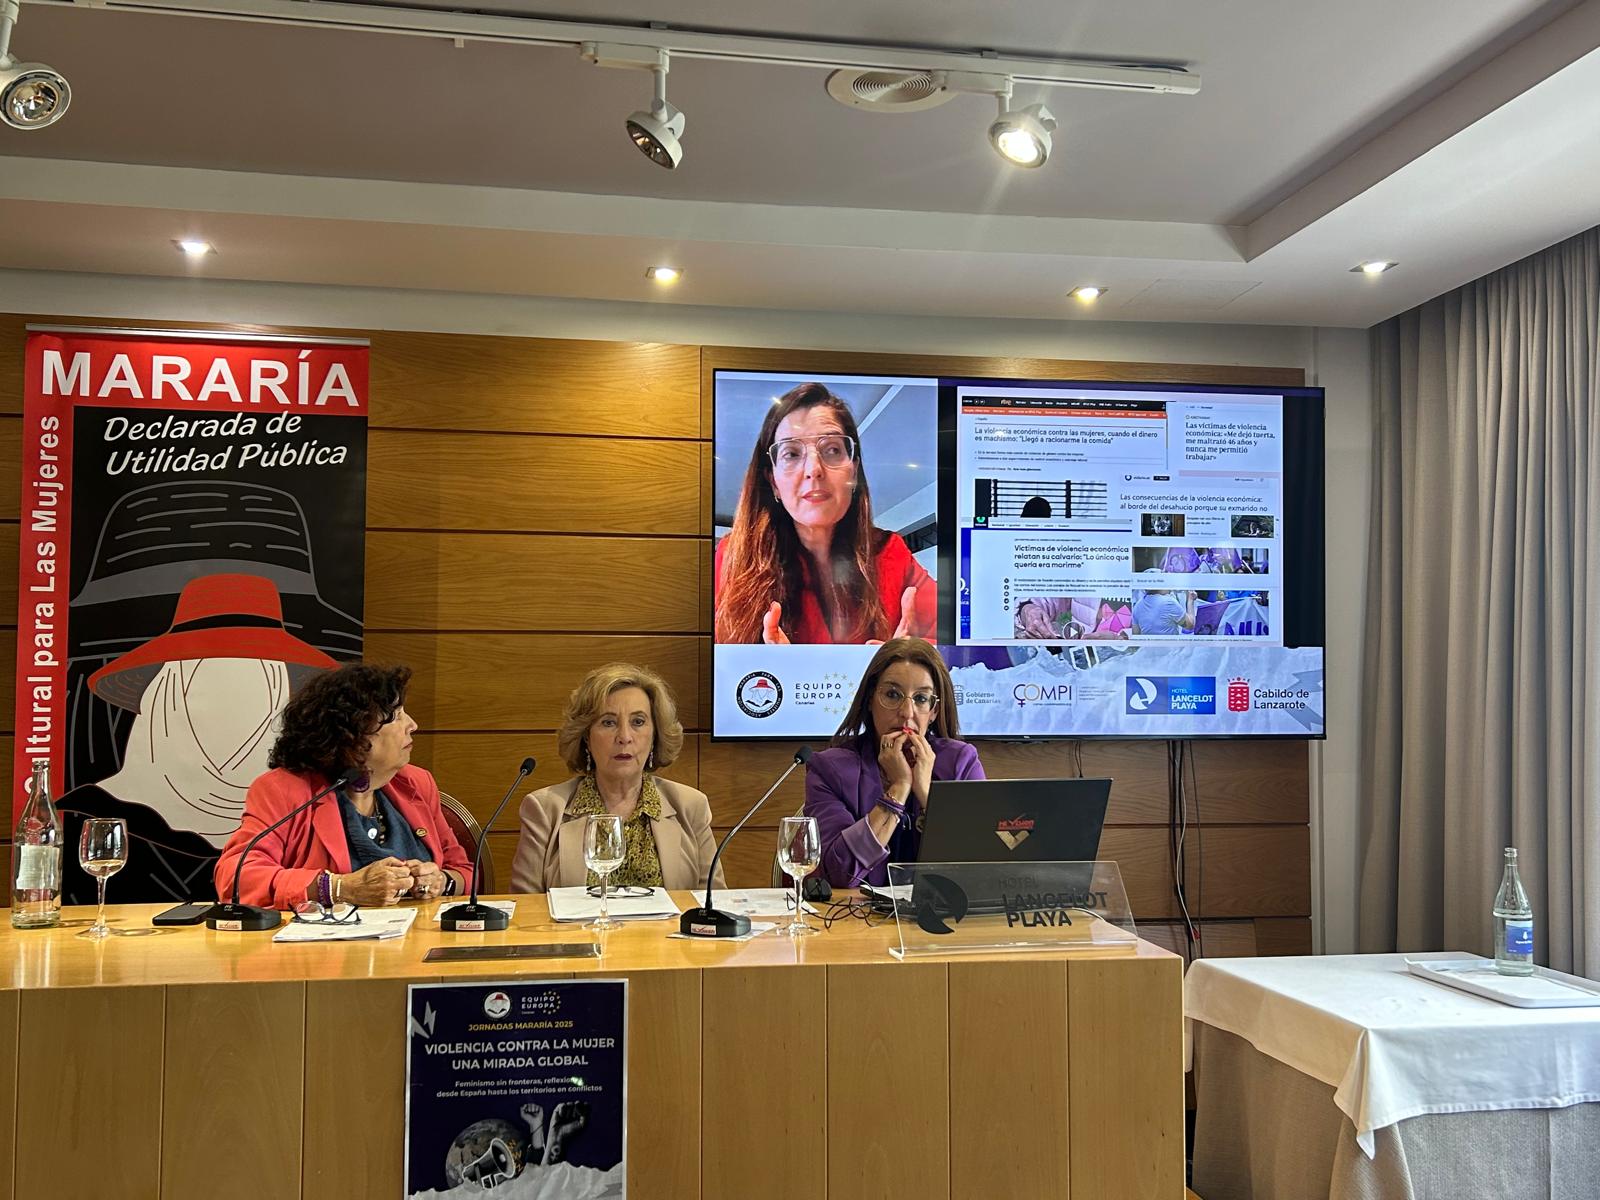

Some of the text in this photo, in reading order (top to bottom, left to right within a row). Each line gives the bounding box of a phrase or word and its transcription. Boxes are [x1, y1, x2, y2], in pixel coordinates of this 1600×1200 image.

[42, 350, 360, 407] MARARÍA
[103, 410, 302, 442] Declarada de
[1080, 430, 1106, 438] mujeres,
[106, 440, 348, 476] Utilidad Pública
[31, 416, 64, 532] Mujeres
[30, 541, 56, 592] Las
[34, 602, 59, 666] para
[1013, 683, 1072, 702] COMPI
[1254, 689, 1309, 699] Cabildo de
[1254, 700, 1306, 709] Lanzarote
[1002, 892, 1107, 909] LANCELOT
[1006, 910, 1072, 928] PLAYA
[468, 1022, 514, 1031] JORNADAS
[515, 1020, 553, 1030] MARARÍA
[425, 1038, 614, 1055] VIOLENCIA CONTRA LA MUJER
[452, 1056, 588, 1070] UNA MIRADA GLOBAL
[436, 1090, 459, 1098] desde
[460, 1089, 486, 1097] España
[520, 1086, 556, 1095] territorios
[568, 1084, 602, 1093] conflictos
[455, 1079, 495, 1088] Feminismo
[508, 1078, 542, 1086] fronteras,
